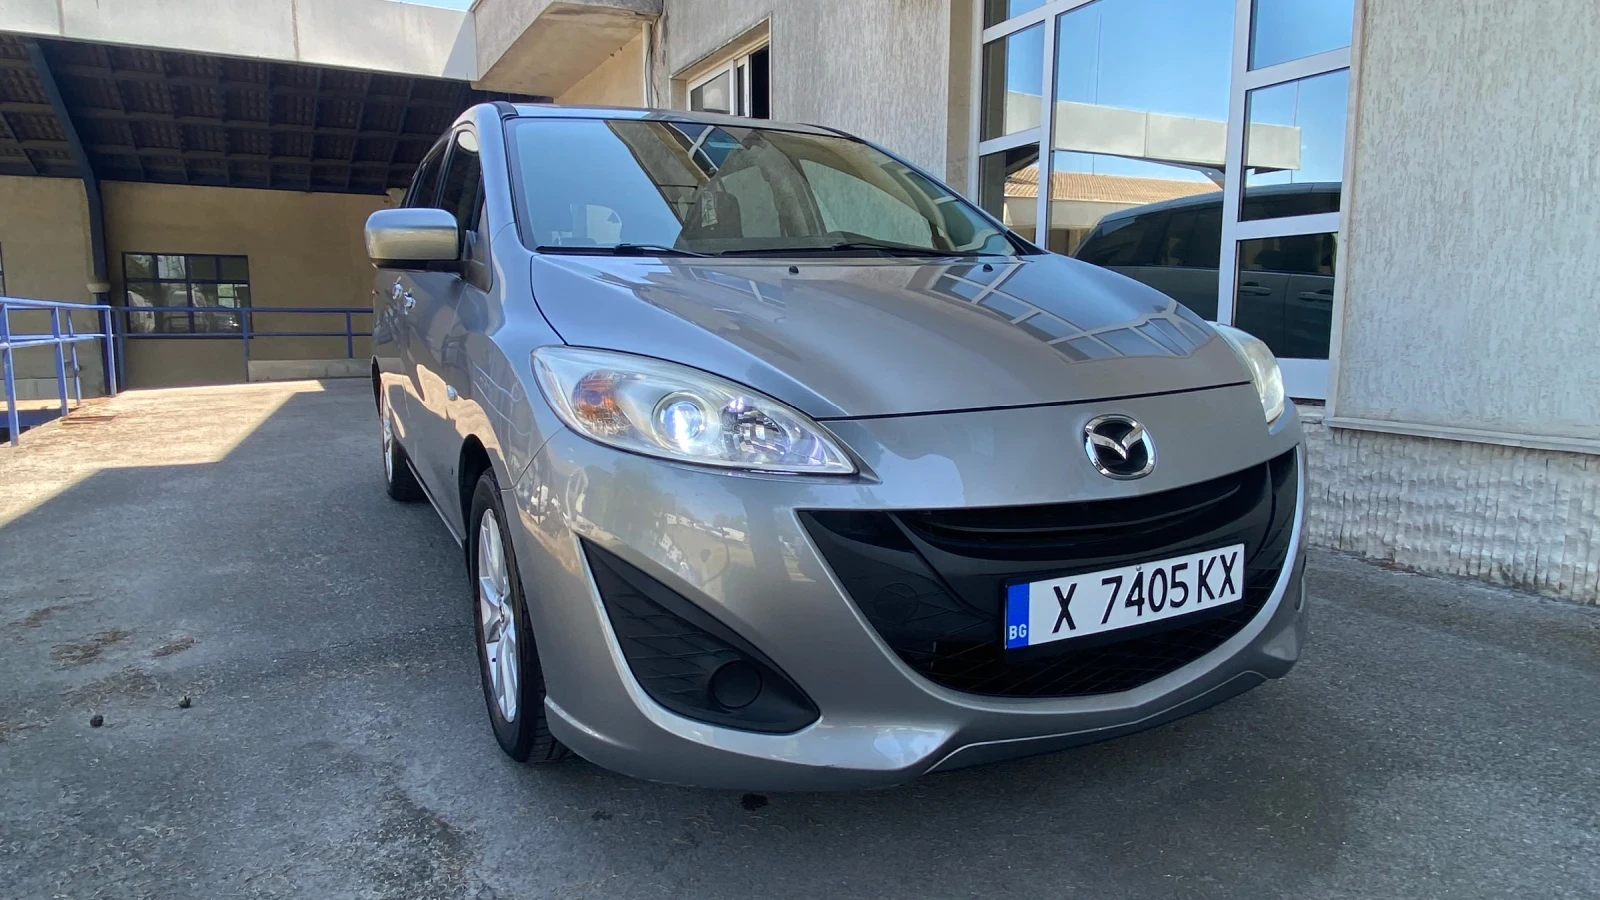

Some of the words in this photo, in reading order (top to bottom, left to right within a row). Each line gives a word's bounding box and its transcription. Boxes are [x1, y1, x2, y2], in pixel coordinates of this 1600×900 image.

[1052, 583, 1077, 633] X
[1101, 562, 1189, 624] 7405
[1197, 551, 1238, 603] KX
[1009, 624, 1027, 640] BG
